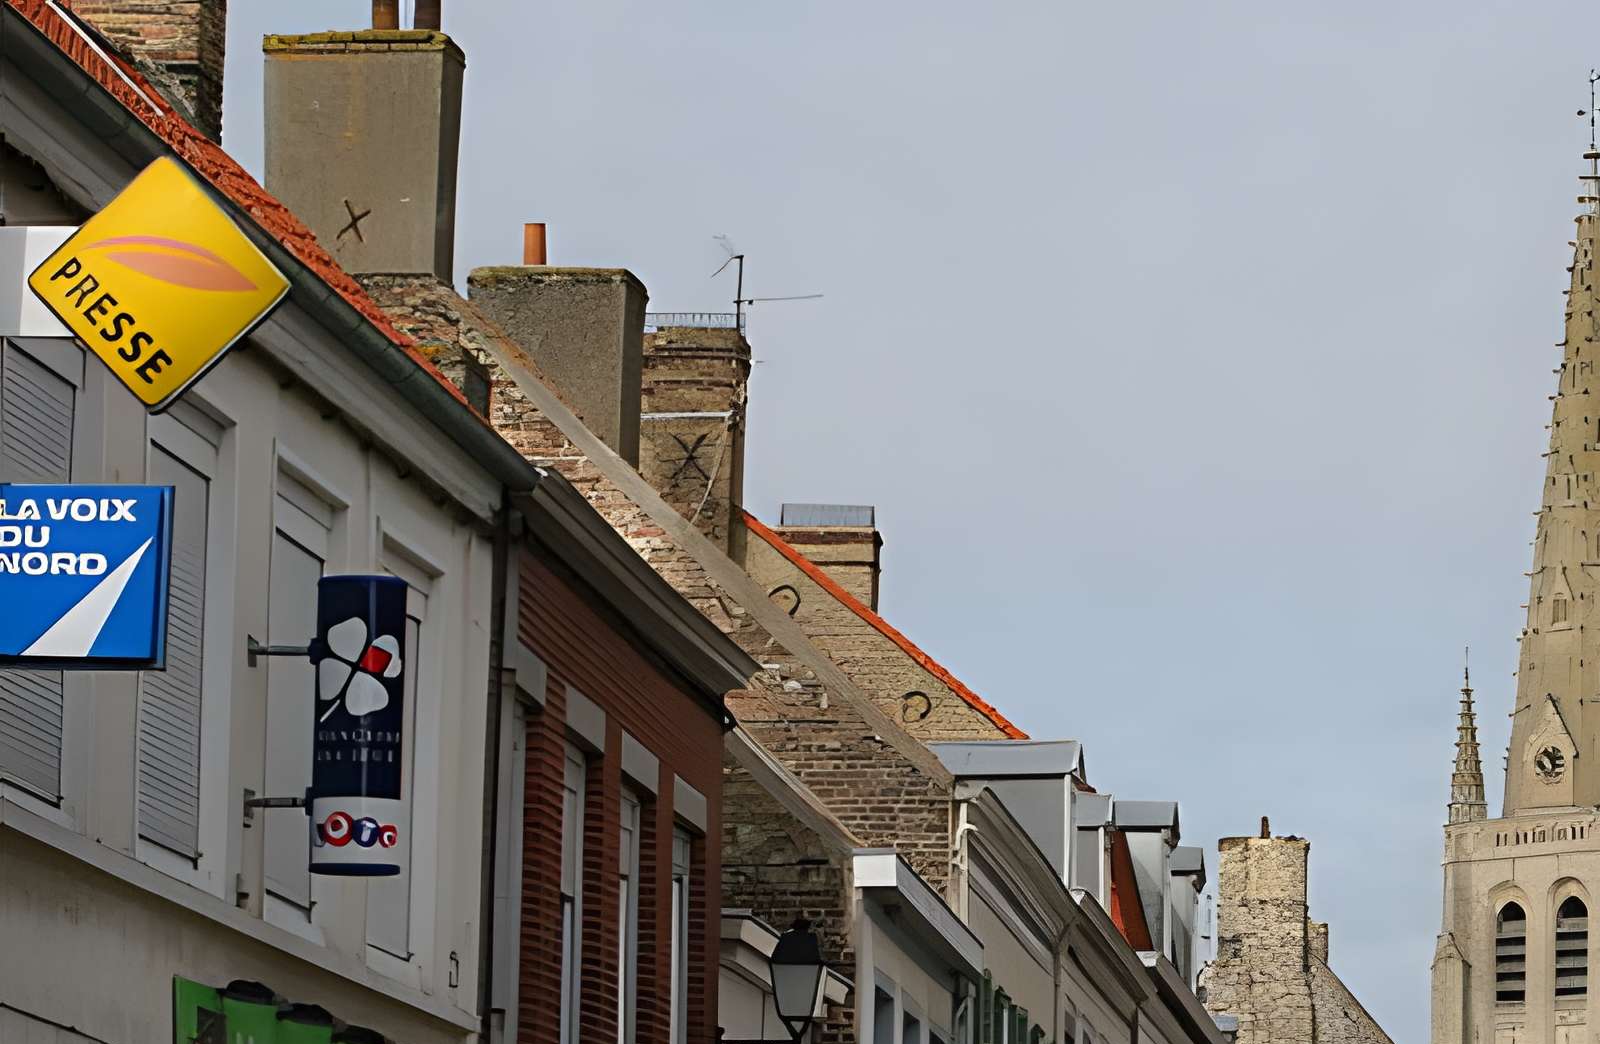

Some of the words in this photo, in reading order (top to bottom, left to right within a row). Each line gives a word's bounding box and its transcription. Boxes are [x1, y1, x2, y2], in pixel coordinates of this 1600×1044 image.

[50, 257, 173, 384] PRESSE
[0, 498, 41, 521] LA
[46, 498, 137, 522] VOIX
[0, 525, 50, 548] DU
[0, 552, 108, 576] NORD
